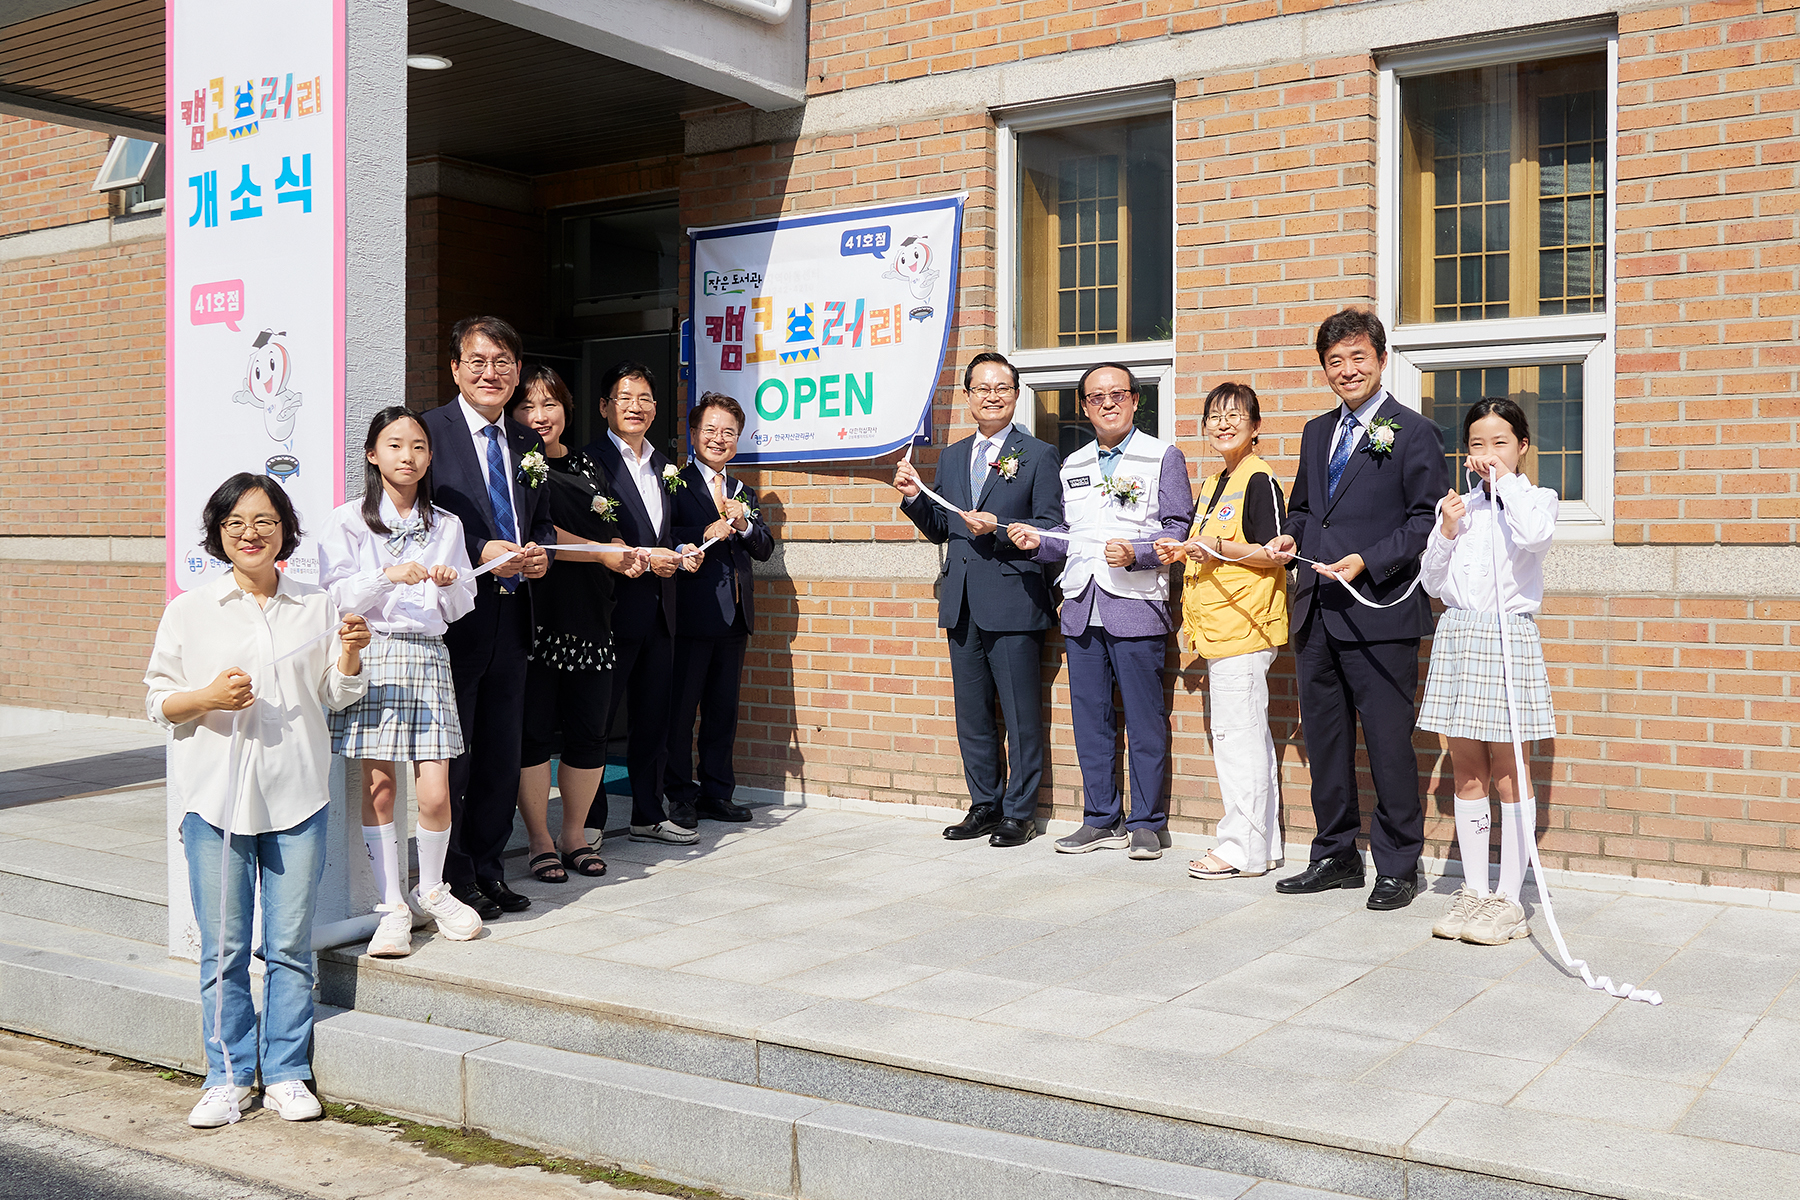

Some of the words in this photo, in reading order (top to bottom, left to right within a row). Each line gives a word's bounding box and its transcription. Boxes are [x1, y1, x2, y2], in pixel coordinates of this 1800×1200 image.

[180, 72, 322, 151] 캠코브러리
[188, 153, 312, 228] 개소식
[845, 232, 887, 249] 41호점
[708, 275, 730, 291] 작은
[731, 272, 763, 288] 도서관
[194, 290, 240, 314] 41호점
[705, 296, 902, 371] 캠코브러리
[754, 371, 874, 421] OPEN
[774, 432, 815, 442] 한국자산관리공사
